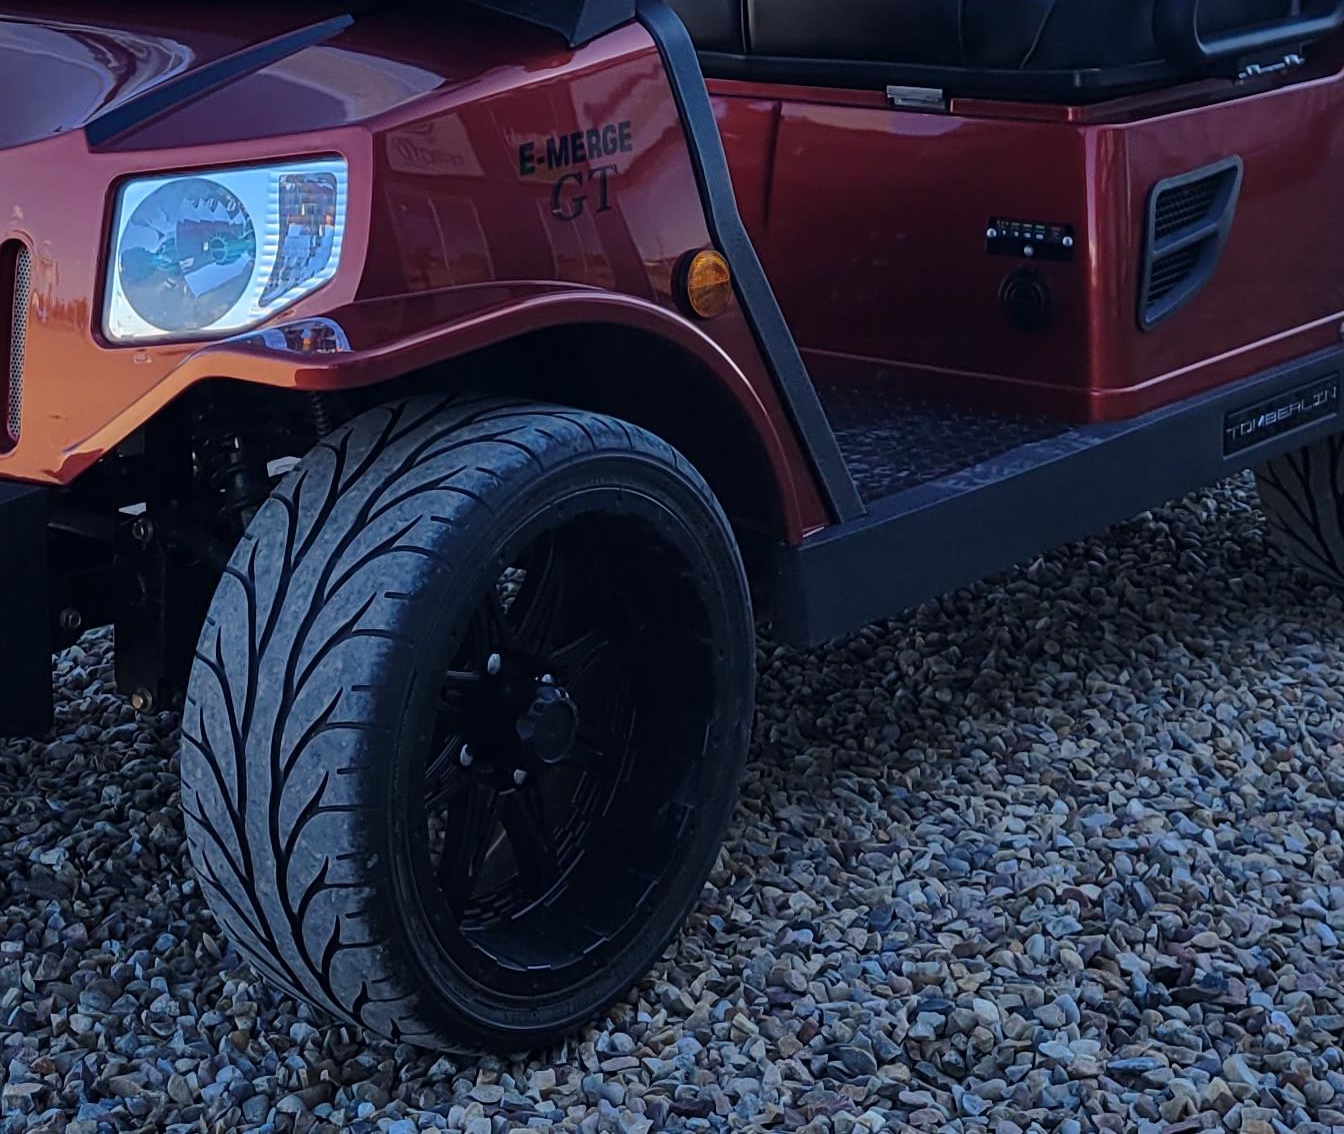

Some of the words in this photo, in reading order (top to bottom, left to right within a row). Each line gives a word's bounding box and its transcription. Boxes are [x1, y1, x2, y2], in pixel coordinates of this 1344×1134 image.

[518, 120, 633, 177] E-MERGE
[550, 164, 618, 222] GT
[1225, 384, 1337, 441] TOMBERLIN
